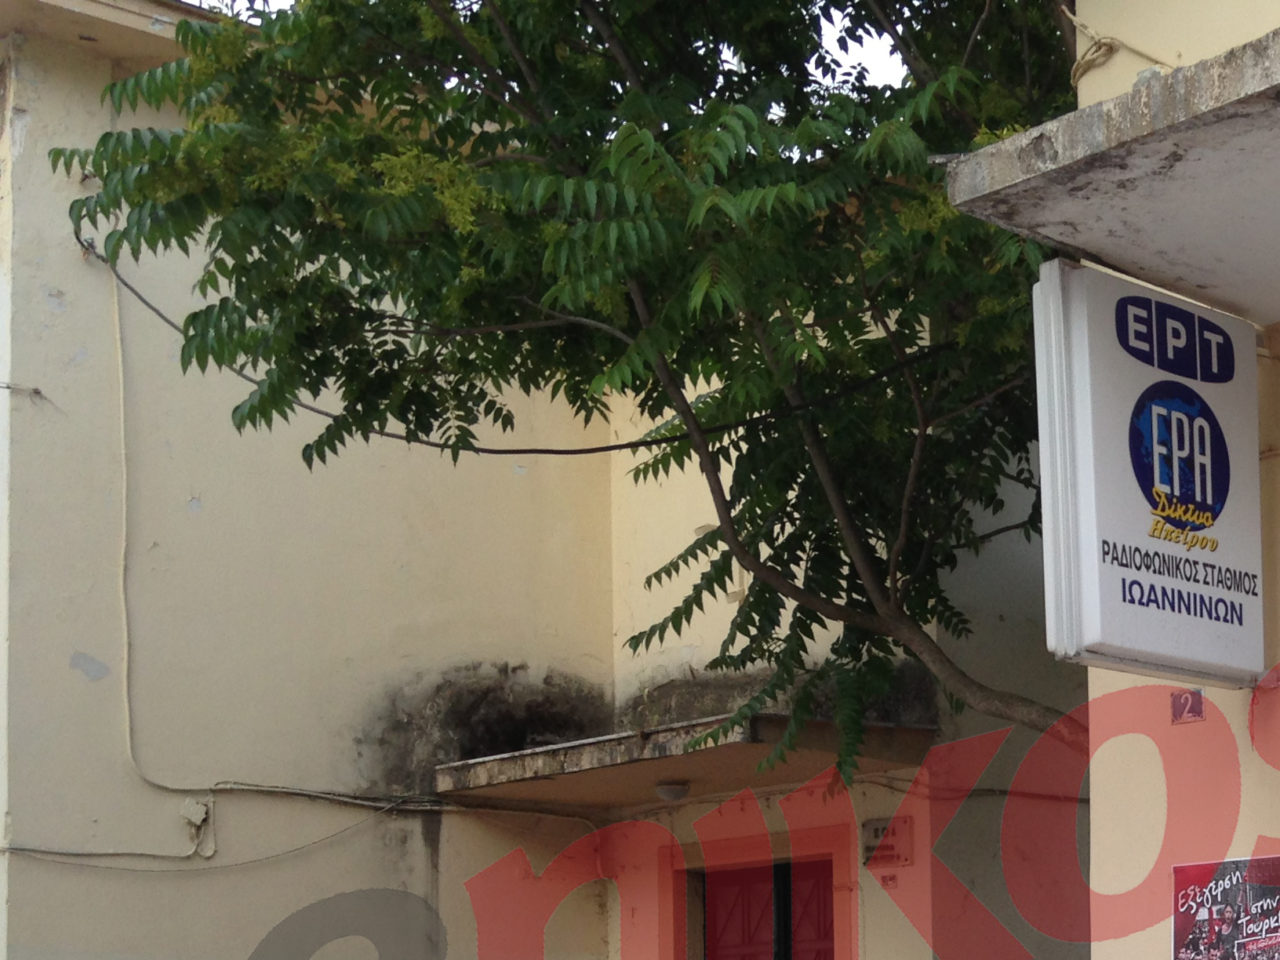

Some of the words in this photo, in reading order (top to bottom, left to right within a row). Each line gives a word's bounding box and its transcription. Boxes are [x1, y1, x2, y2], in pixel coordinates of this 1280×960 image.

[1127, 304, 1224, 374] ΕΡΤ
[1151, 404, 1213, 506] ΕΡΑ
[1102, 539, 1200, 584] ΡΑΔΙΟΦΩΝΙΚΟΣ
[1202, 562, 1258, 597] ΣΤΑΘΜΟΣ
[1121, 578, 1243, 626] ΙΩΑΝΝΙΝΩΝ
[1180, 693, 1193, 720] 2
